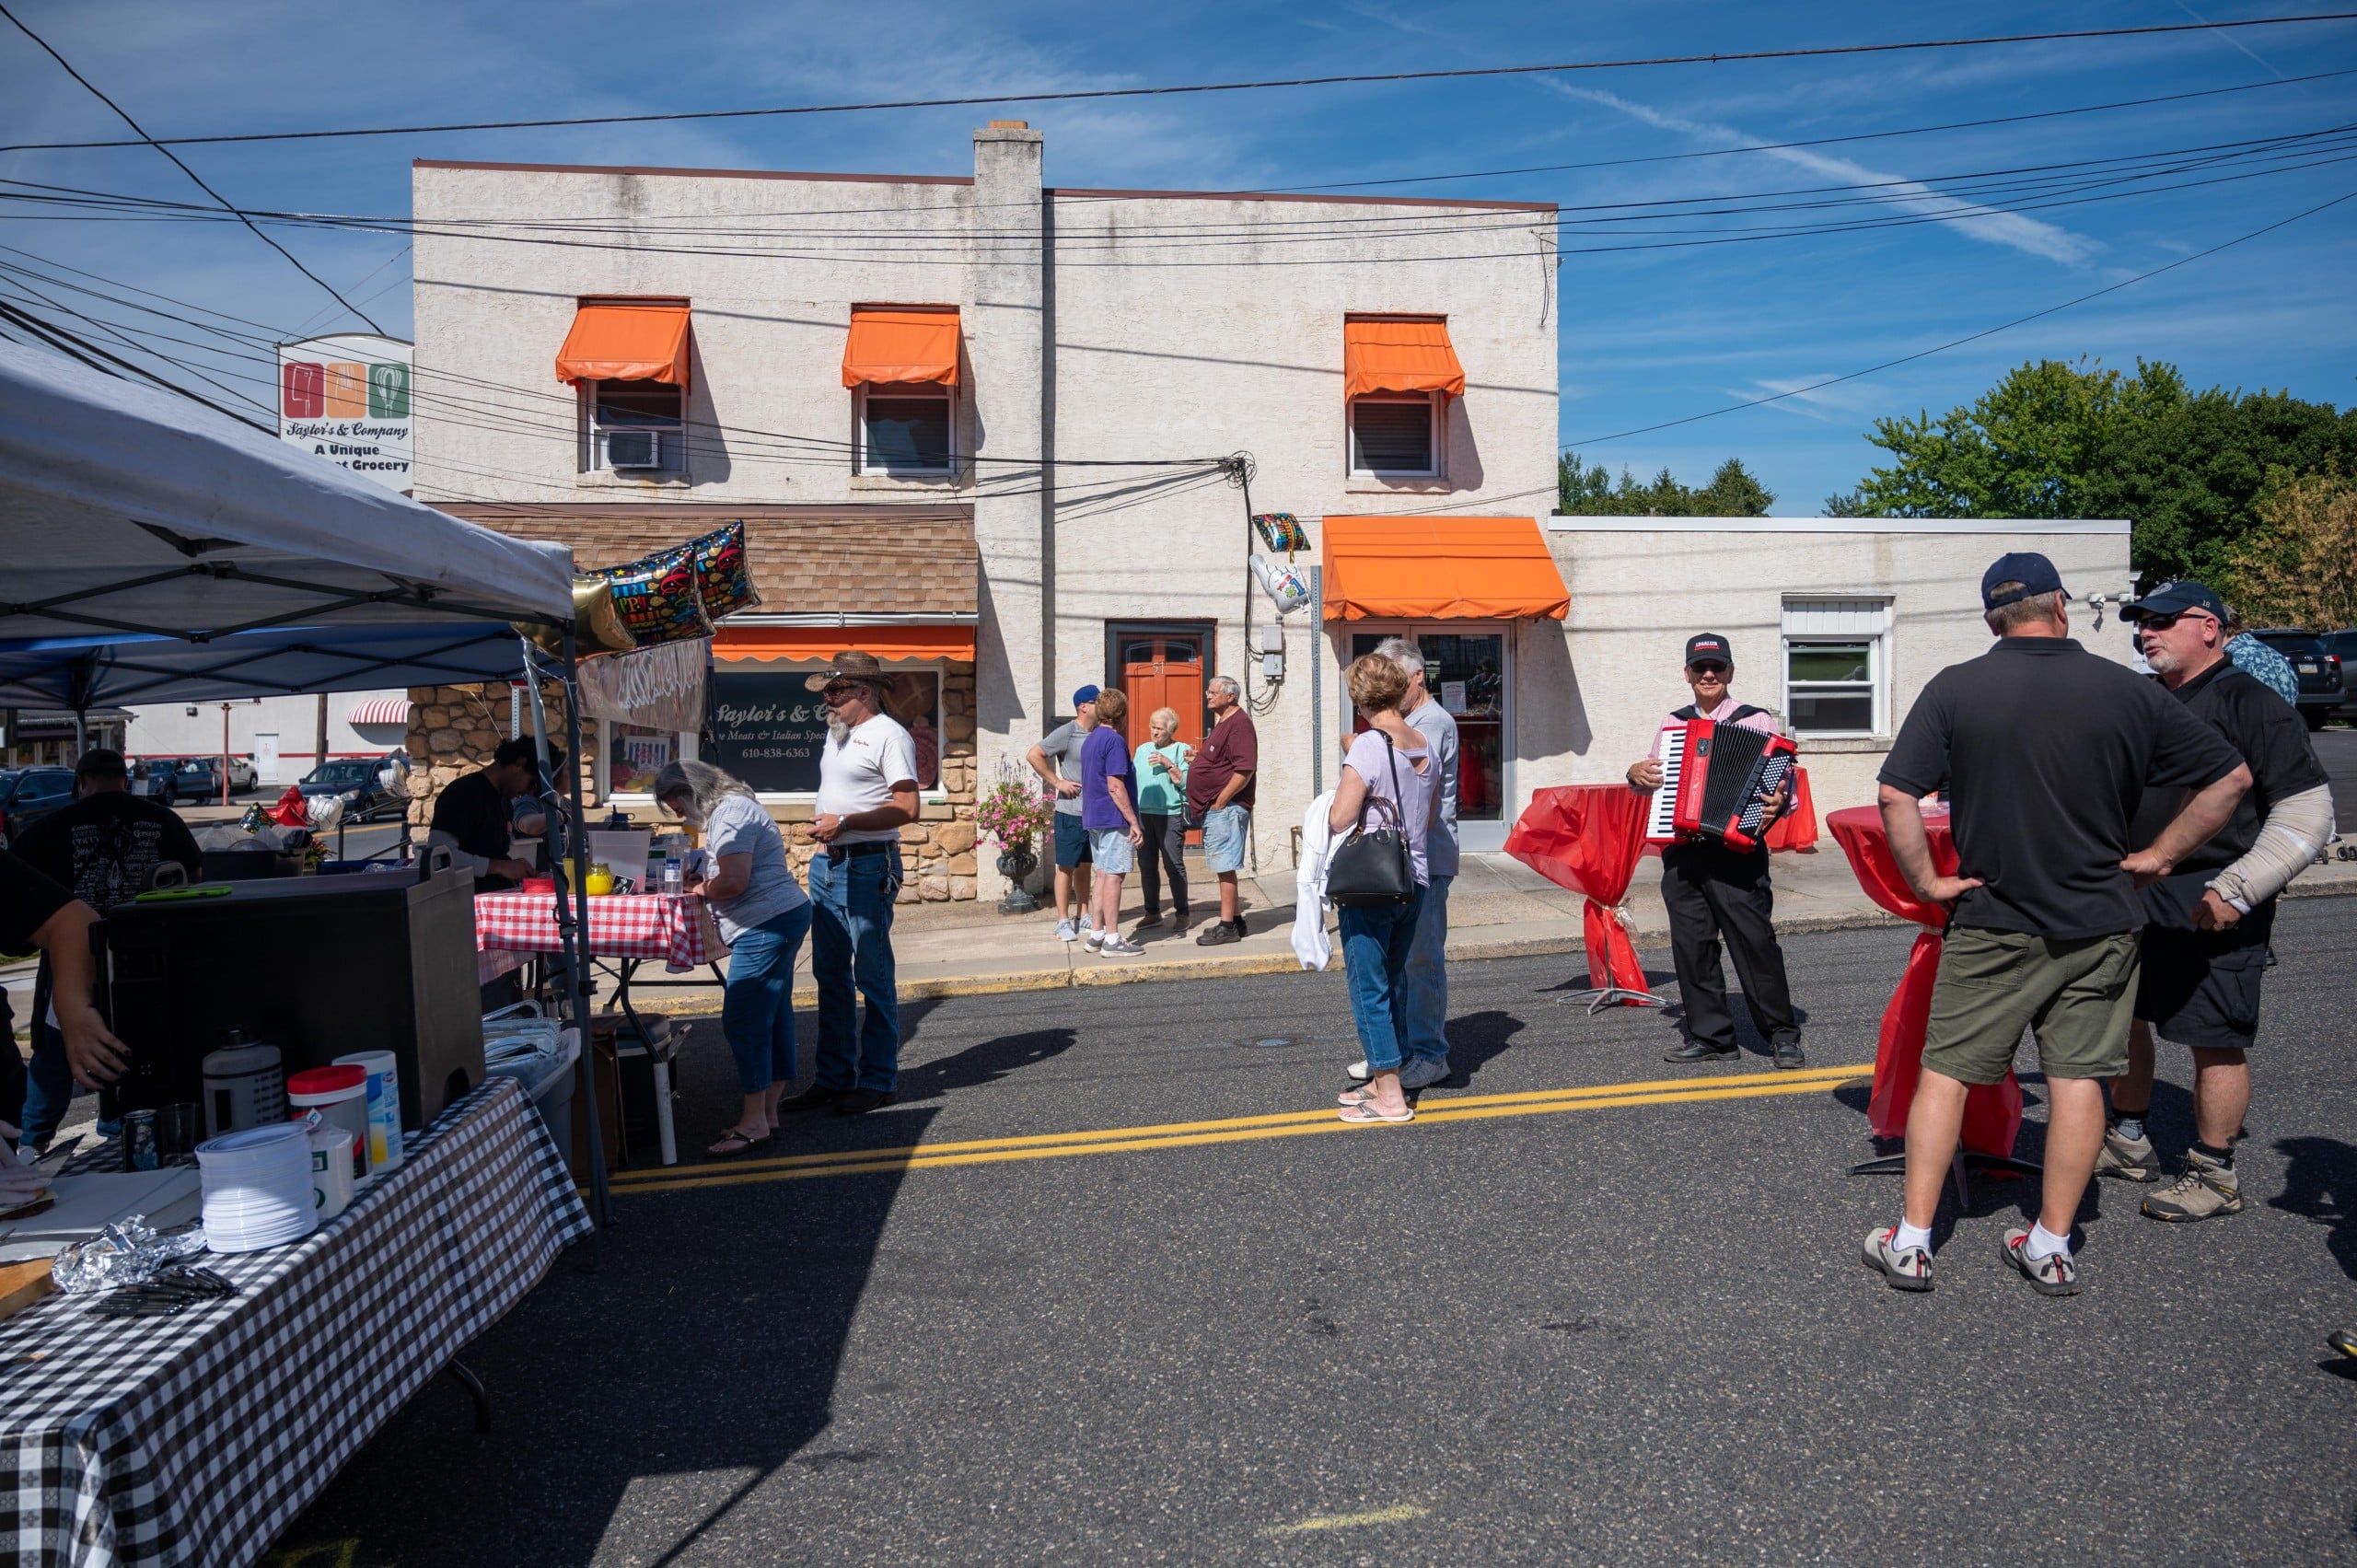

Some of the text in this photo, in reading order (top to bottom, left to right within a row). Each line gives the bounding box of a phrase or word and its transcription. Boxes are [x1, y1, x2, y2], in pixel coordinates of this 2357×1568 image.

[286, 422, 408, 440] Saylor's & Company
[315, 445, 380, 458] A Unique
[353, 459, 409, 472] Grocery
[1153, 662, 1165, 675] 51
[790, 704, 810, 723] &
[727, 730, 755, 740] Meats
[758, 730, 771, 740] &
[772, 730, 802, 740] Italian
[804, 730, 827, 742] Speci
[742, 748, 810, 759] 610-838-6363
